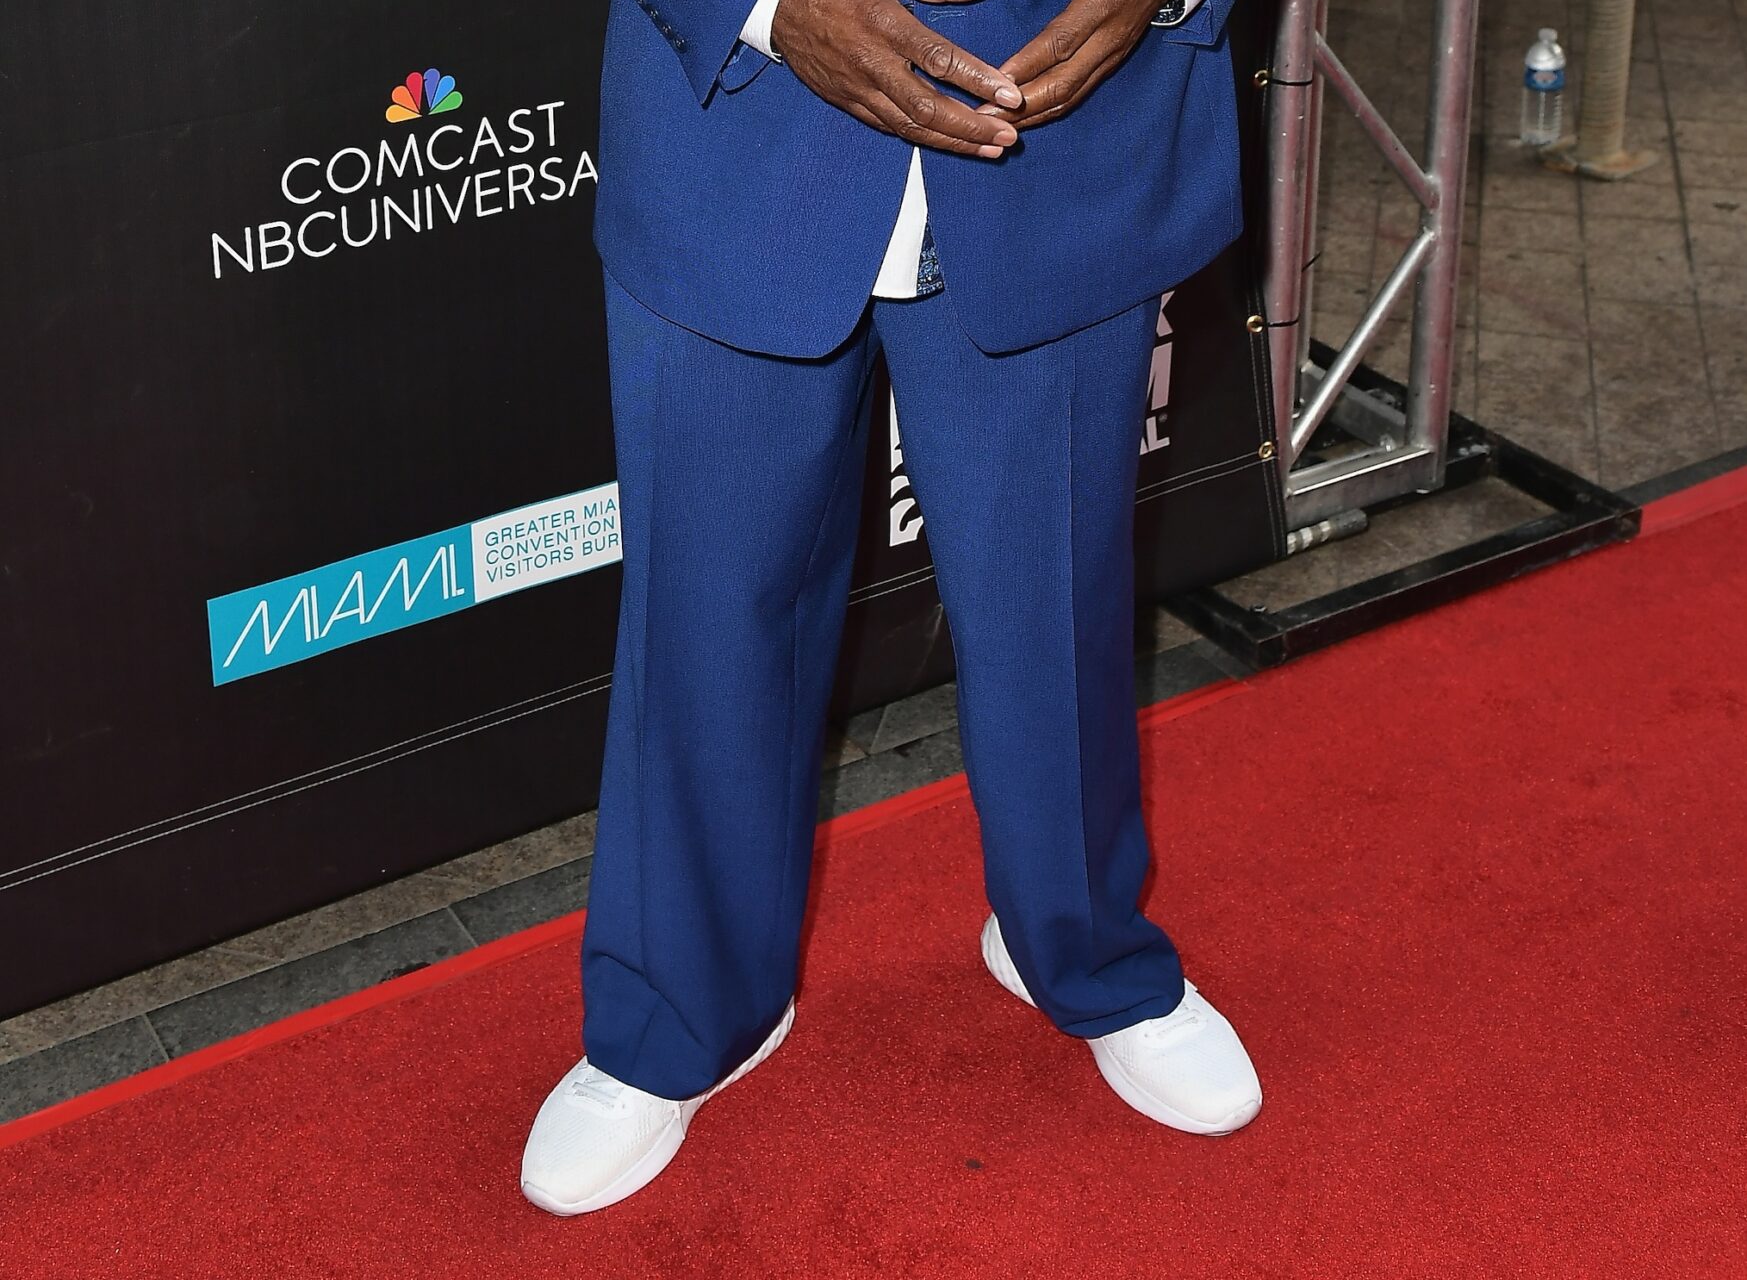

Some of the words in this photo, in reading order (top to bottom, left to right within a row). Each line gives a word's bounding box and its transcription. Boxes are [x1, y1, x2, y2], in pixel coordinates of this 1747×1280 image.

[281, 101, 564, 205] COMCAST
[212, 150, 598, 279] NBCUNIVERSA
[485, 509, 575, 547] GREATER
[583, 498, 617, 520] MIA
[486, 516, 615, 565] CONVENTION
[486, 546, 574, 583] VISITORS
[582, 533, 619, 556] BUR
